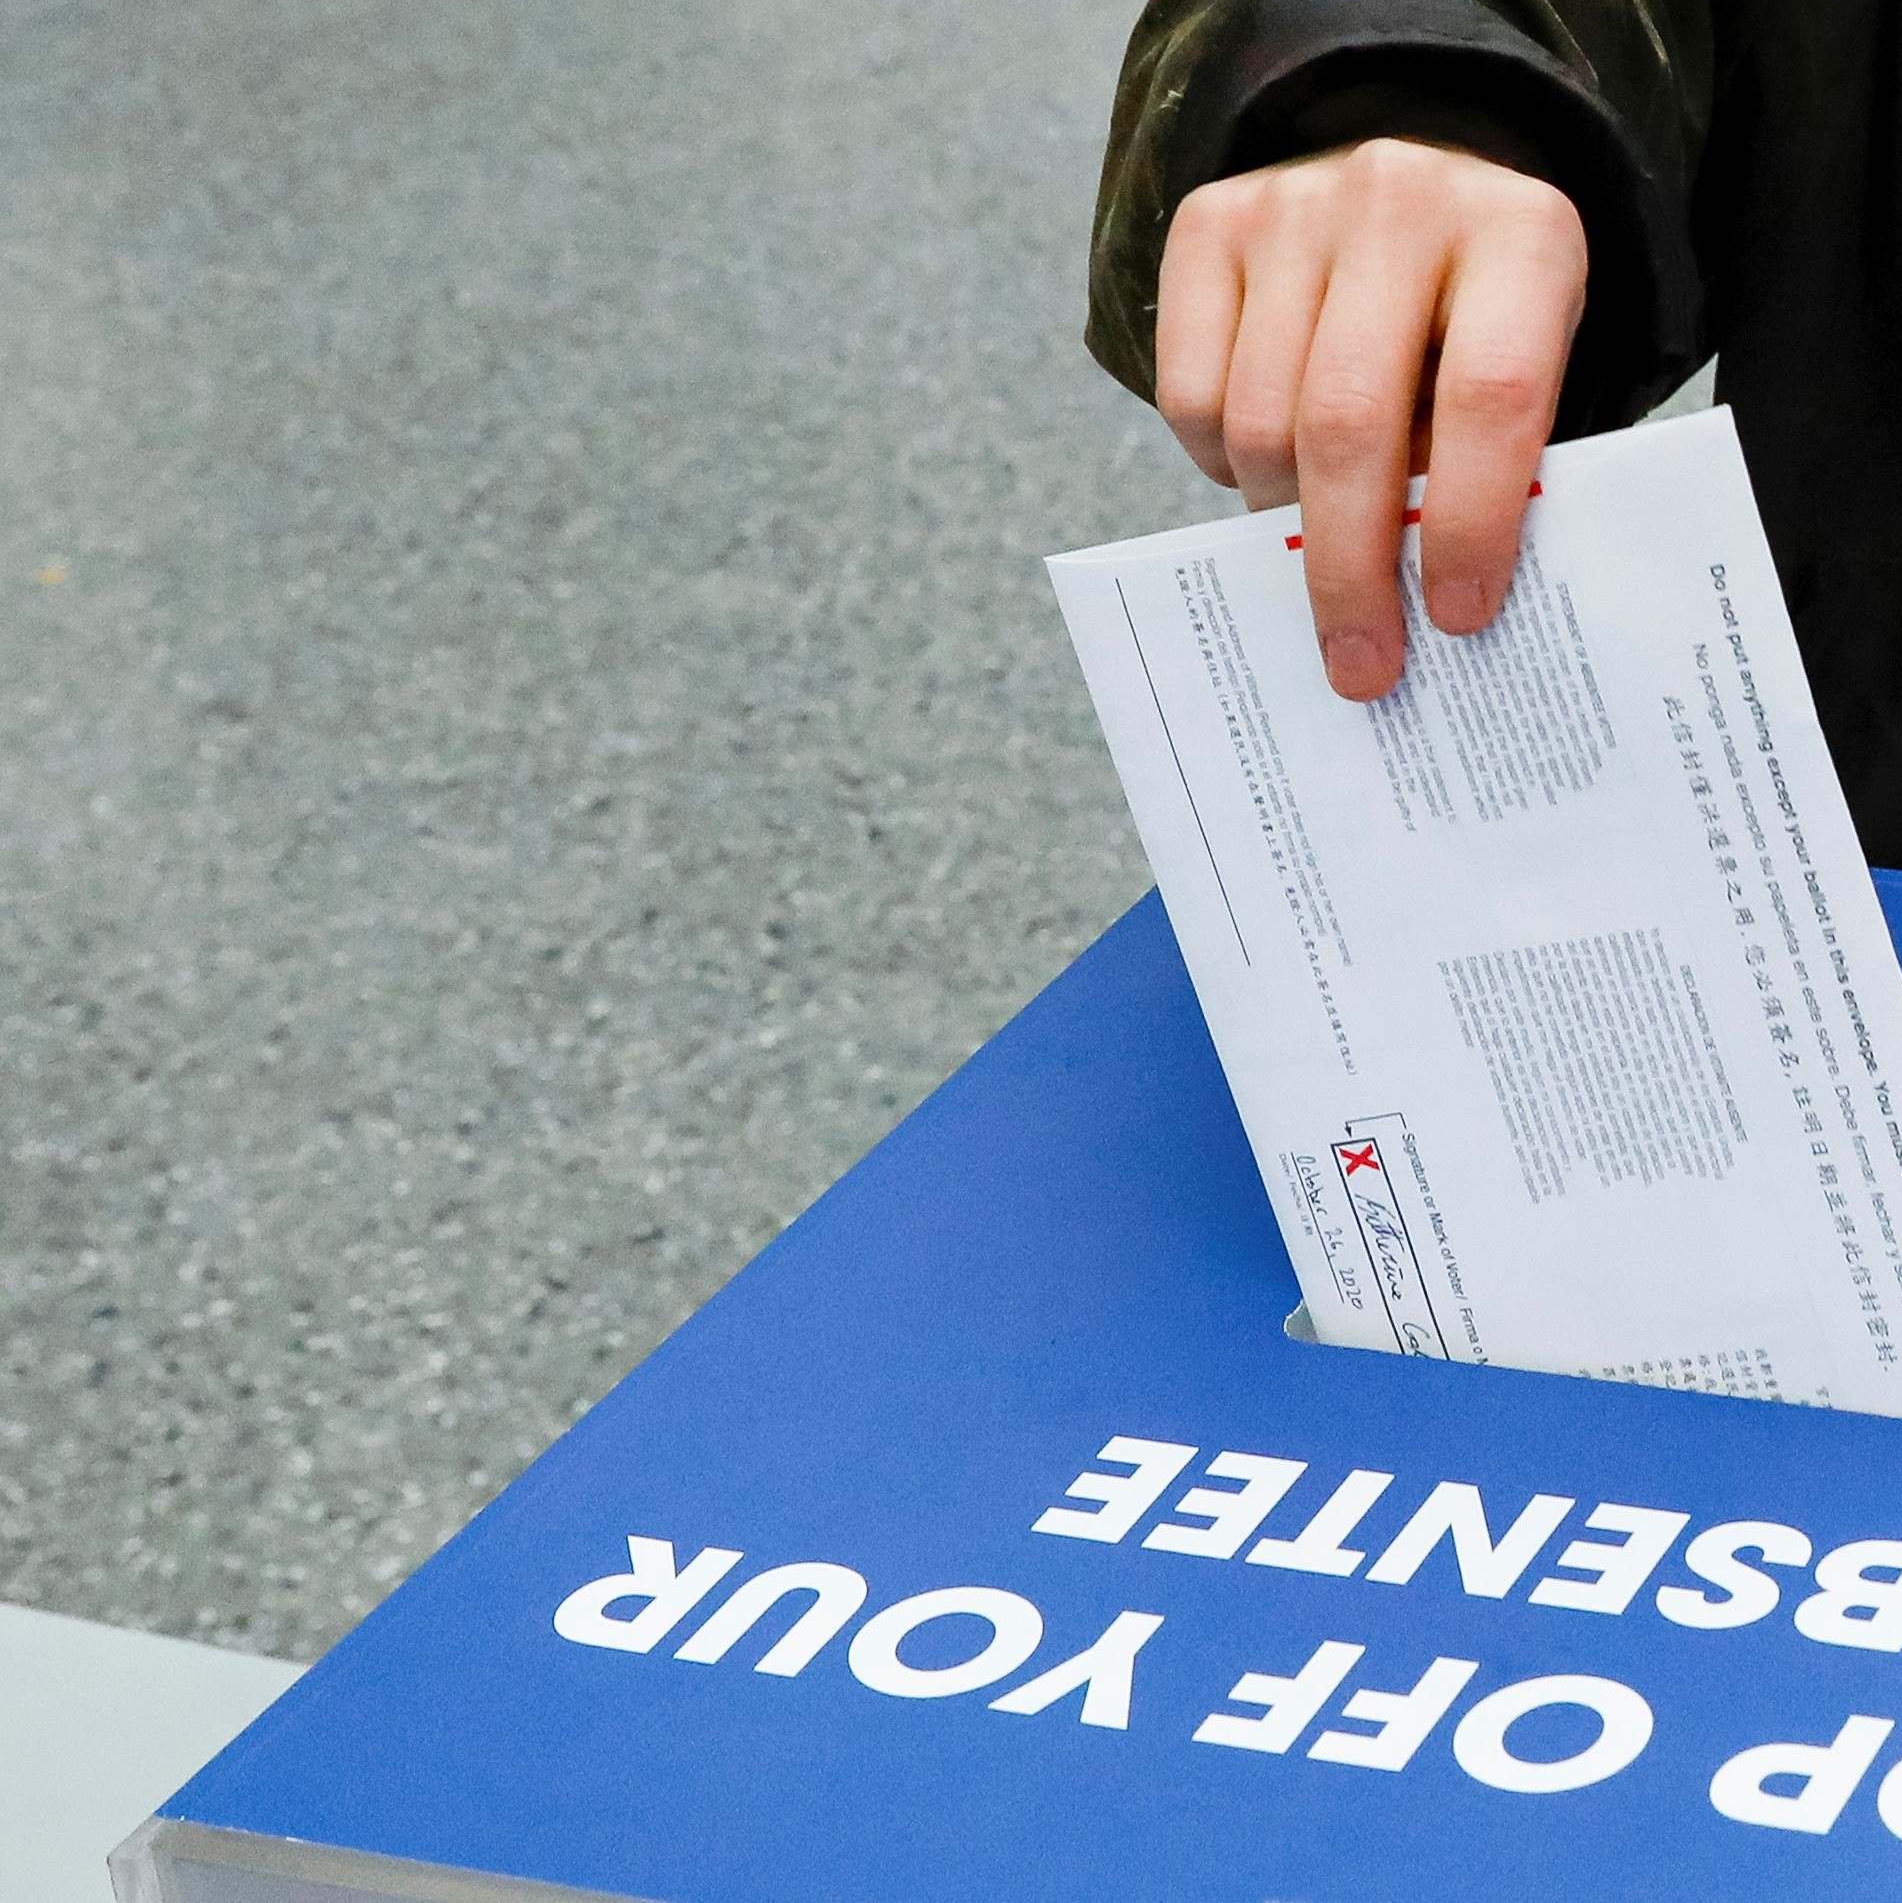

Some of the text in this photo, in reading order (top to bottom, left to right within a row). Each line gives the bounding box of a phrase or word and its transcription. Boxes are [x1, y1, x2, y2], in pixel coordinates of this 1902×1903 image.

[1707, 562, 1730, 591] Do
[1717, 595, 1740, 629] not
[1691, 641, 1713, 670] No
[1725, 631, 1749, 666] put
[1696, 672, 1730, 731] ponga
[1735, 667, 1777, 753] anything
[1719, 732, 1747, 779] nada
[1764, 755, 1798, 821] except
[1731, 781, 1770, 854] excepto
[1758, 854, 1777, 879] su
[1784, 821, 1813, 870] your
[1802, 868, 1833, 924] ballot
[1764, 878, 1803, 957] papeleta
[1821, 926, 1839, 945] in
[1792, 958, 1810, 983] en
[1828, 947, 1852, 983] this
[1800, 984, 1826, 1025] este
[1840, 986, 1883, 1077] envelope.
[1813, 1025, 1845, 1081] sobre.
[1833, 1082, 1861, 1133] Debe
[1872, 1078, 1897, 1116] You
[1398, 1130, 1432, 1195] Signature
[1423, 1195, 1436, 1211] or
[1867, 1190, 1900, 1249] fechar
[1294, 1151, 1332, 1218] October
[1338, 1266, 1365, 1312] 2020
[1428, 1210, 1449, 1245] Mark
[1440, 1247, 1455, 1262] of
[1883, 1248, 1900, 1260] y
[1444, 1261, 1467, 1303] Voter/
[1459, 1306, 1480, 1344] Firma
[1472, 1345, 1482, 1354] o
[553, 1535, 1165, 1730] YOUR
[1192, 1640, 1654, 1793] OFF
